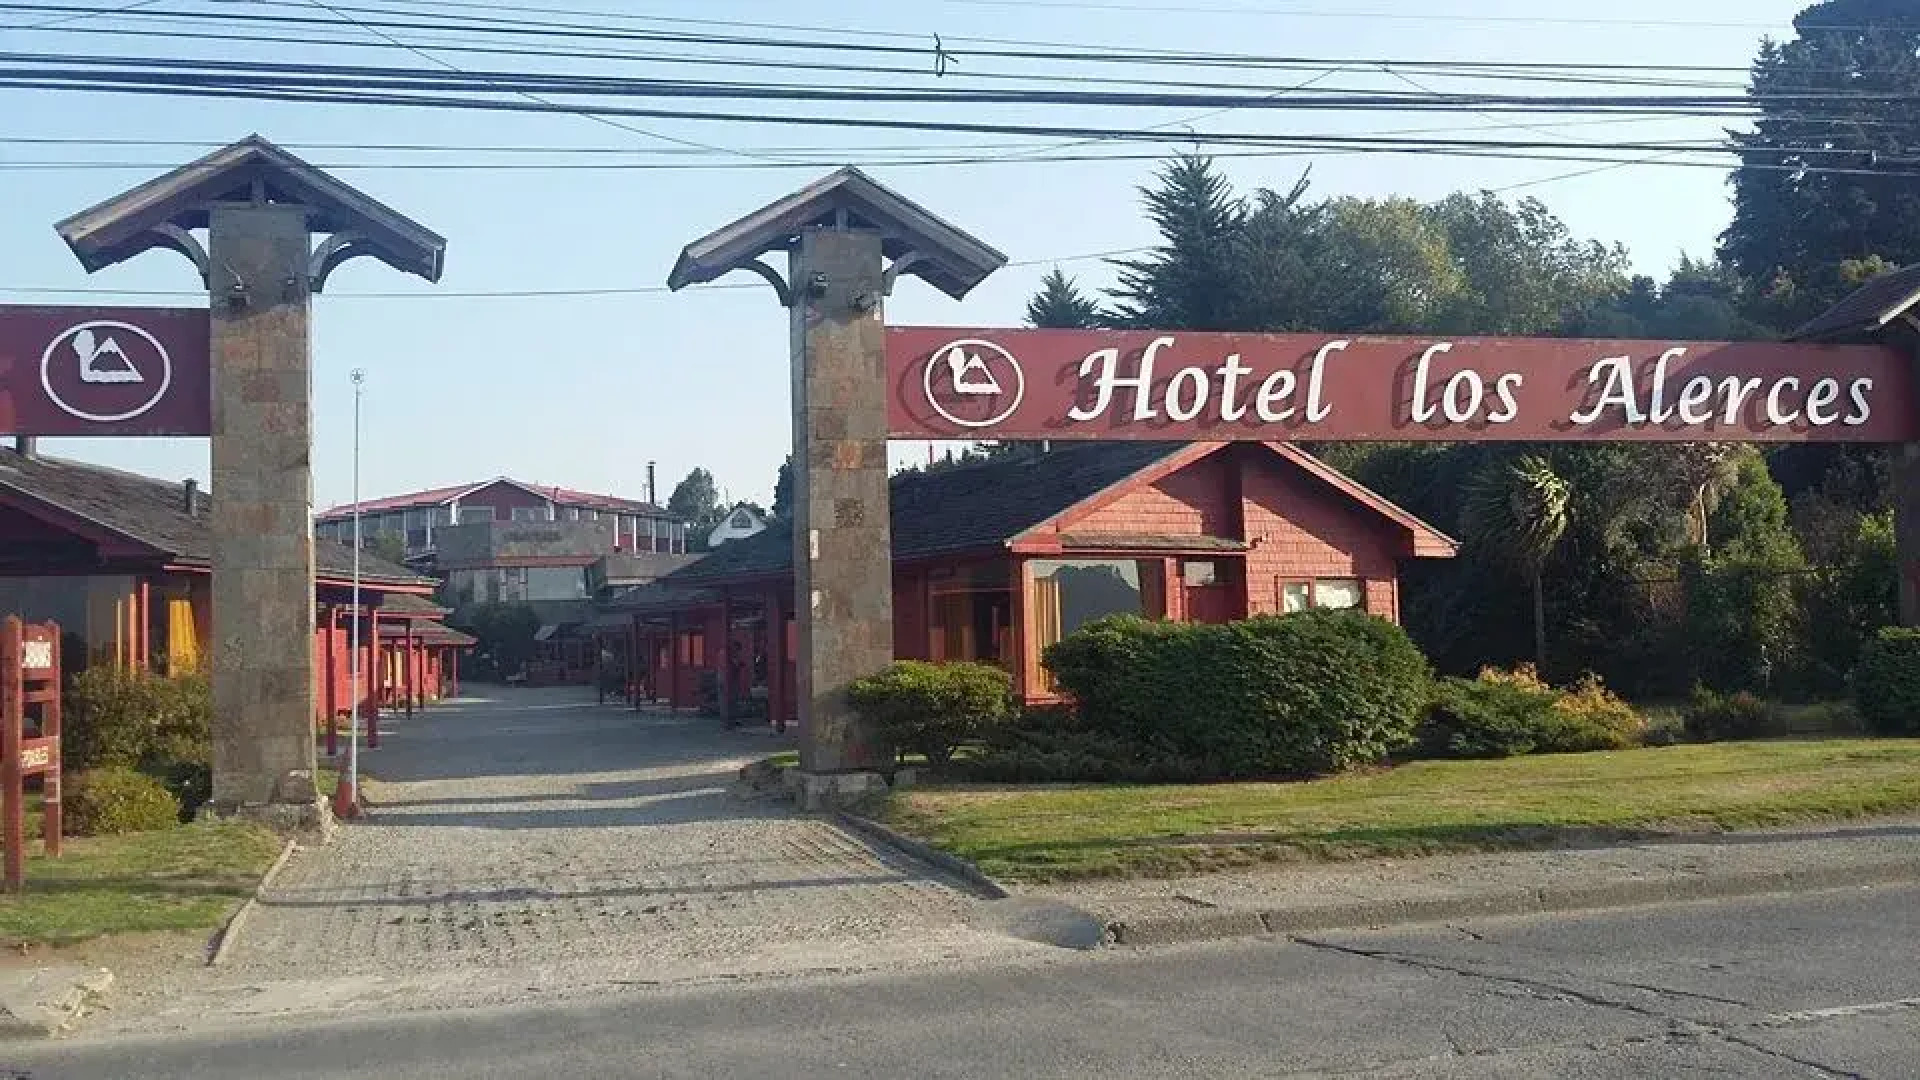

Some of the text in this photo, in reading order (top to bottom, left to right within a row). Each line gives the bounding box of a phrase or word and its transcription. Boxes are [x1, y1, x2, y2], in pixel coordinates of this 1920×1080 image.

[1068, 337, 1873, 425] Hotel los Alerces
